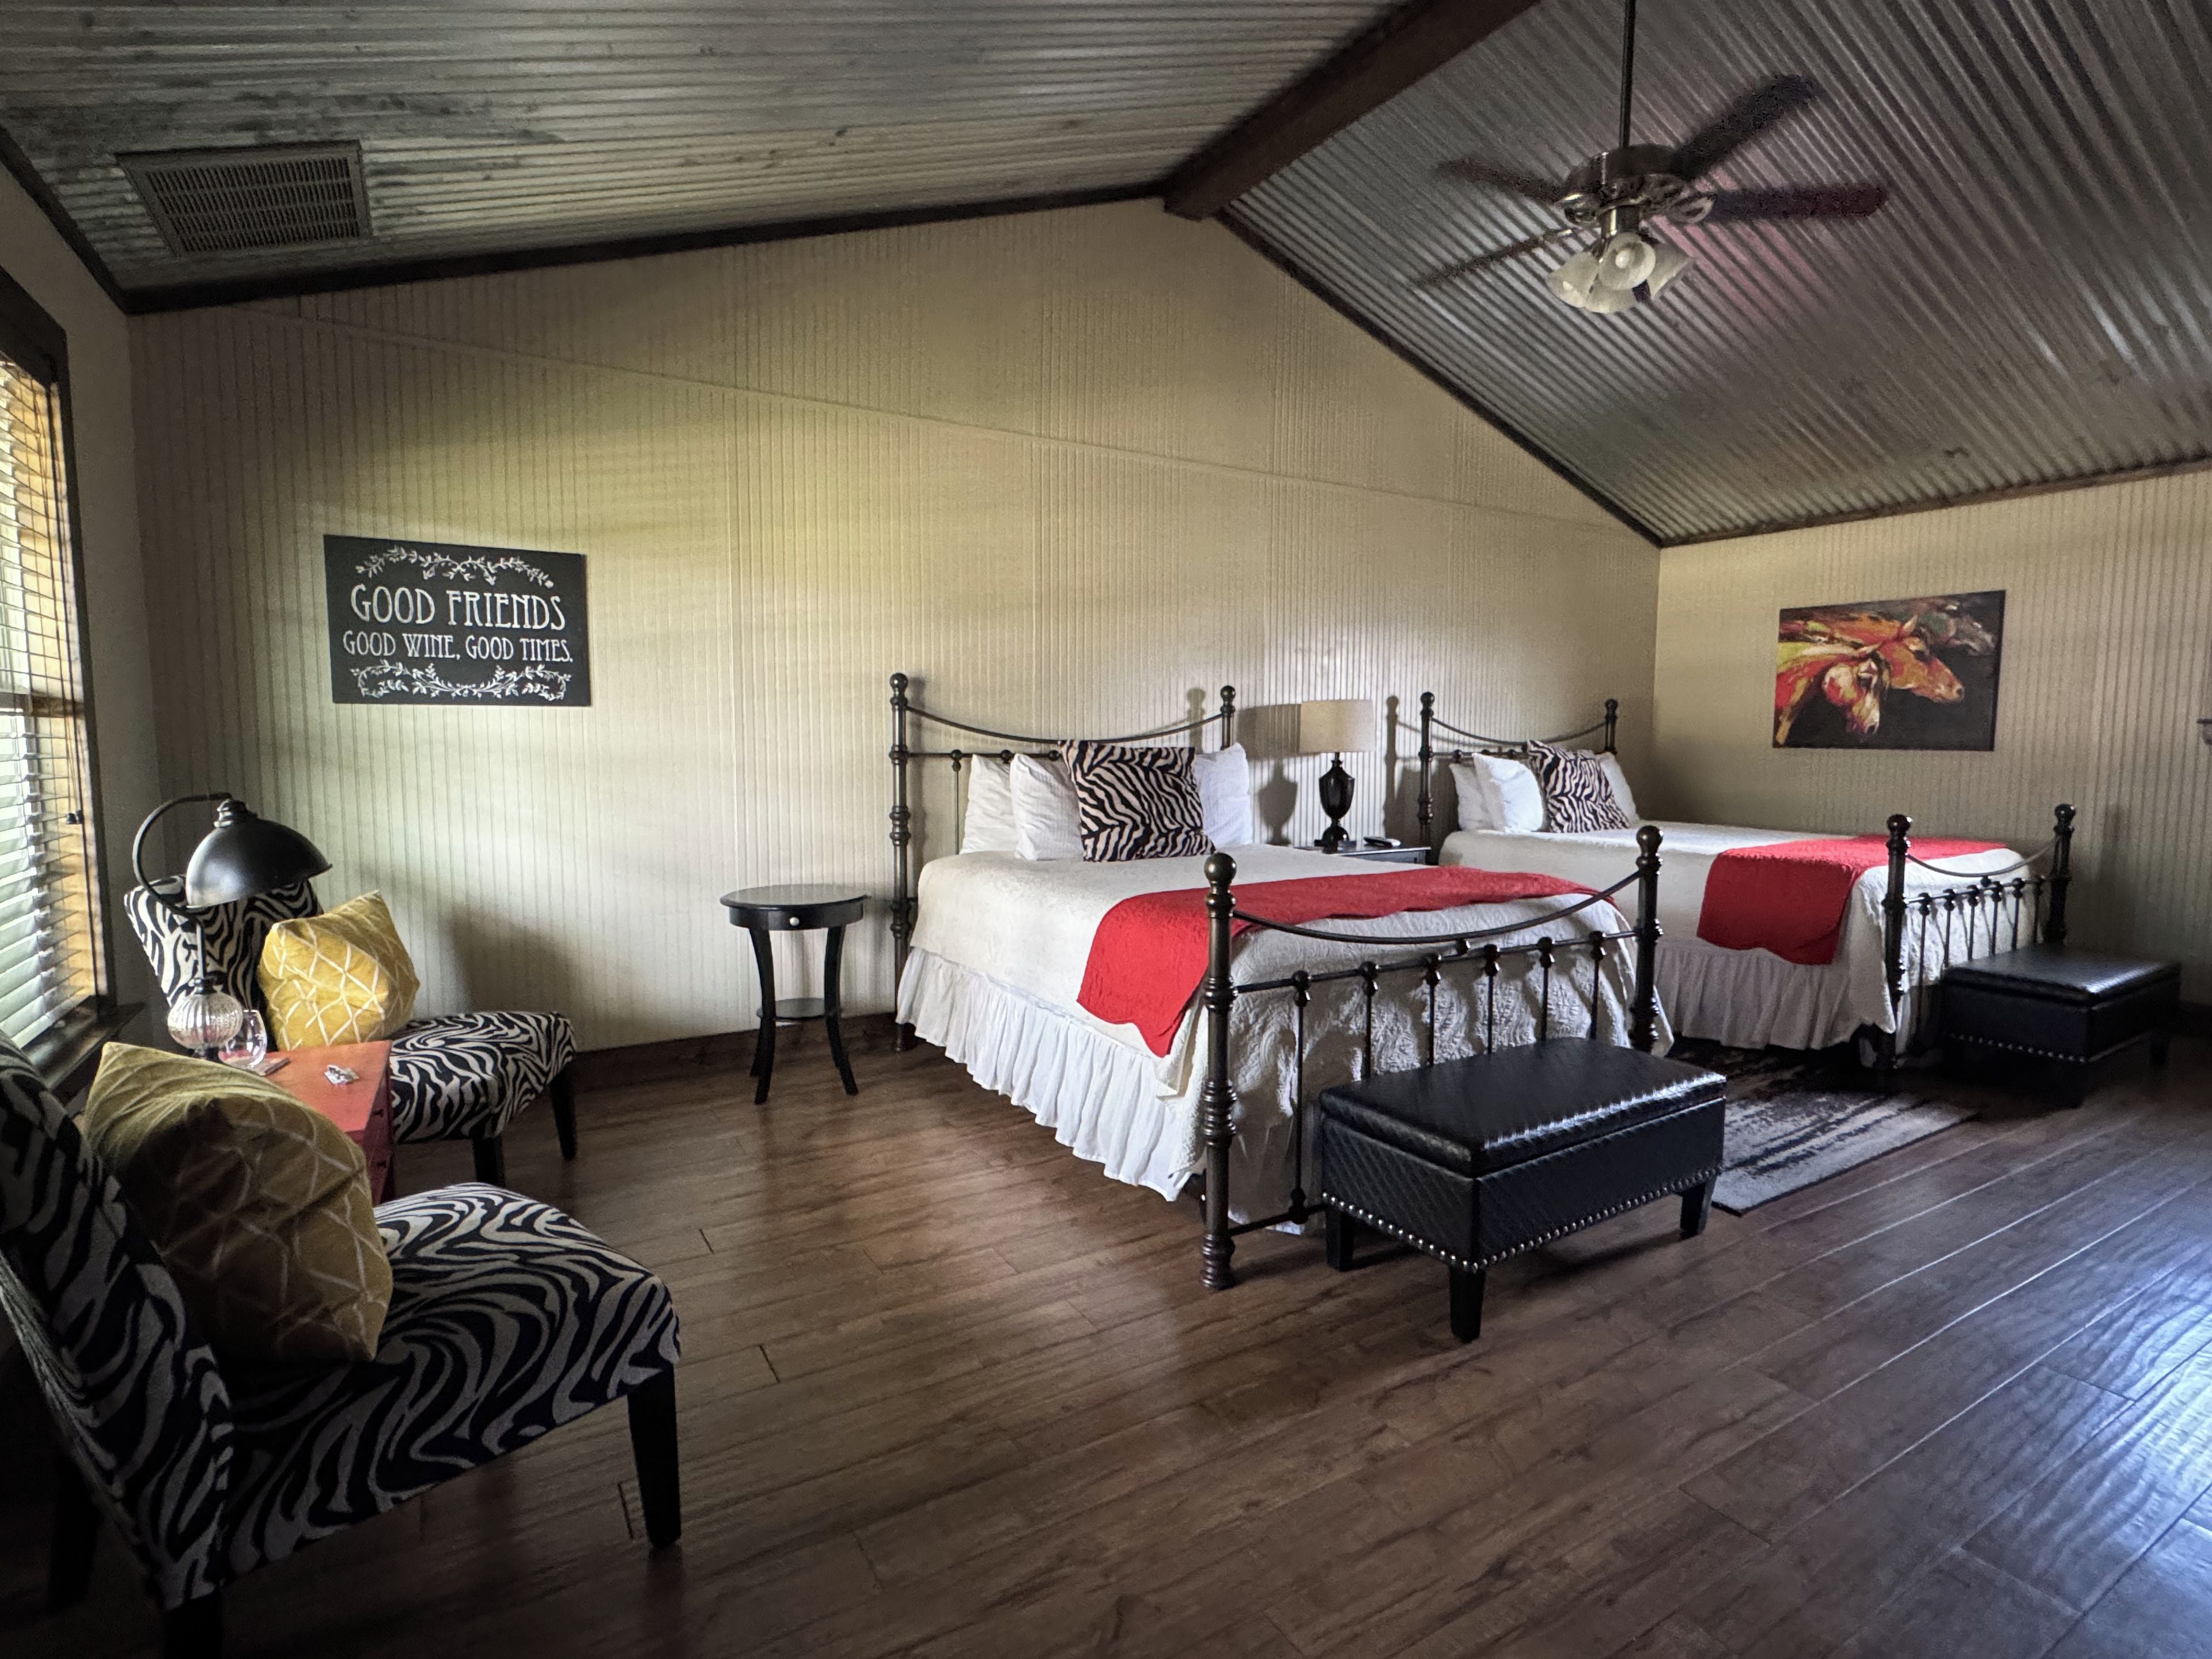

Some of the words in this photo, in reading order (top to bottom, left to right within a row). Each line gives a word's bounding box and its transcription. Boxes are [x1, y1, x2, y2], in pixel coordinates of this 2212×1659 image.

[351, 584, 435, 624] GOOD
[446, 589, 566, 631] FRIENDS
[343, 630, 396, 656] GOOD
[402, 632, 461, 661] WINE,
[465, 634, 514, 660] GOOD
[518, 637, 574, 663] TIMES.
